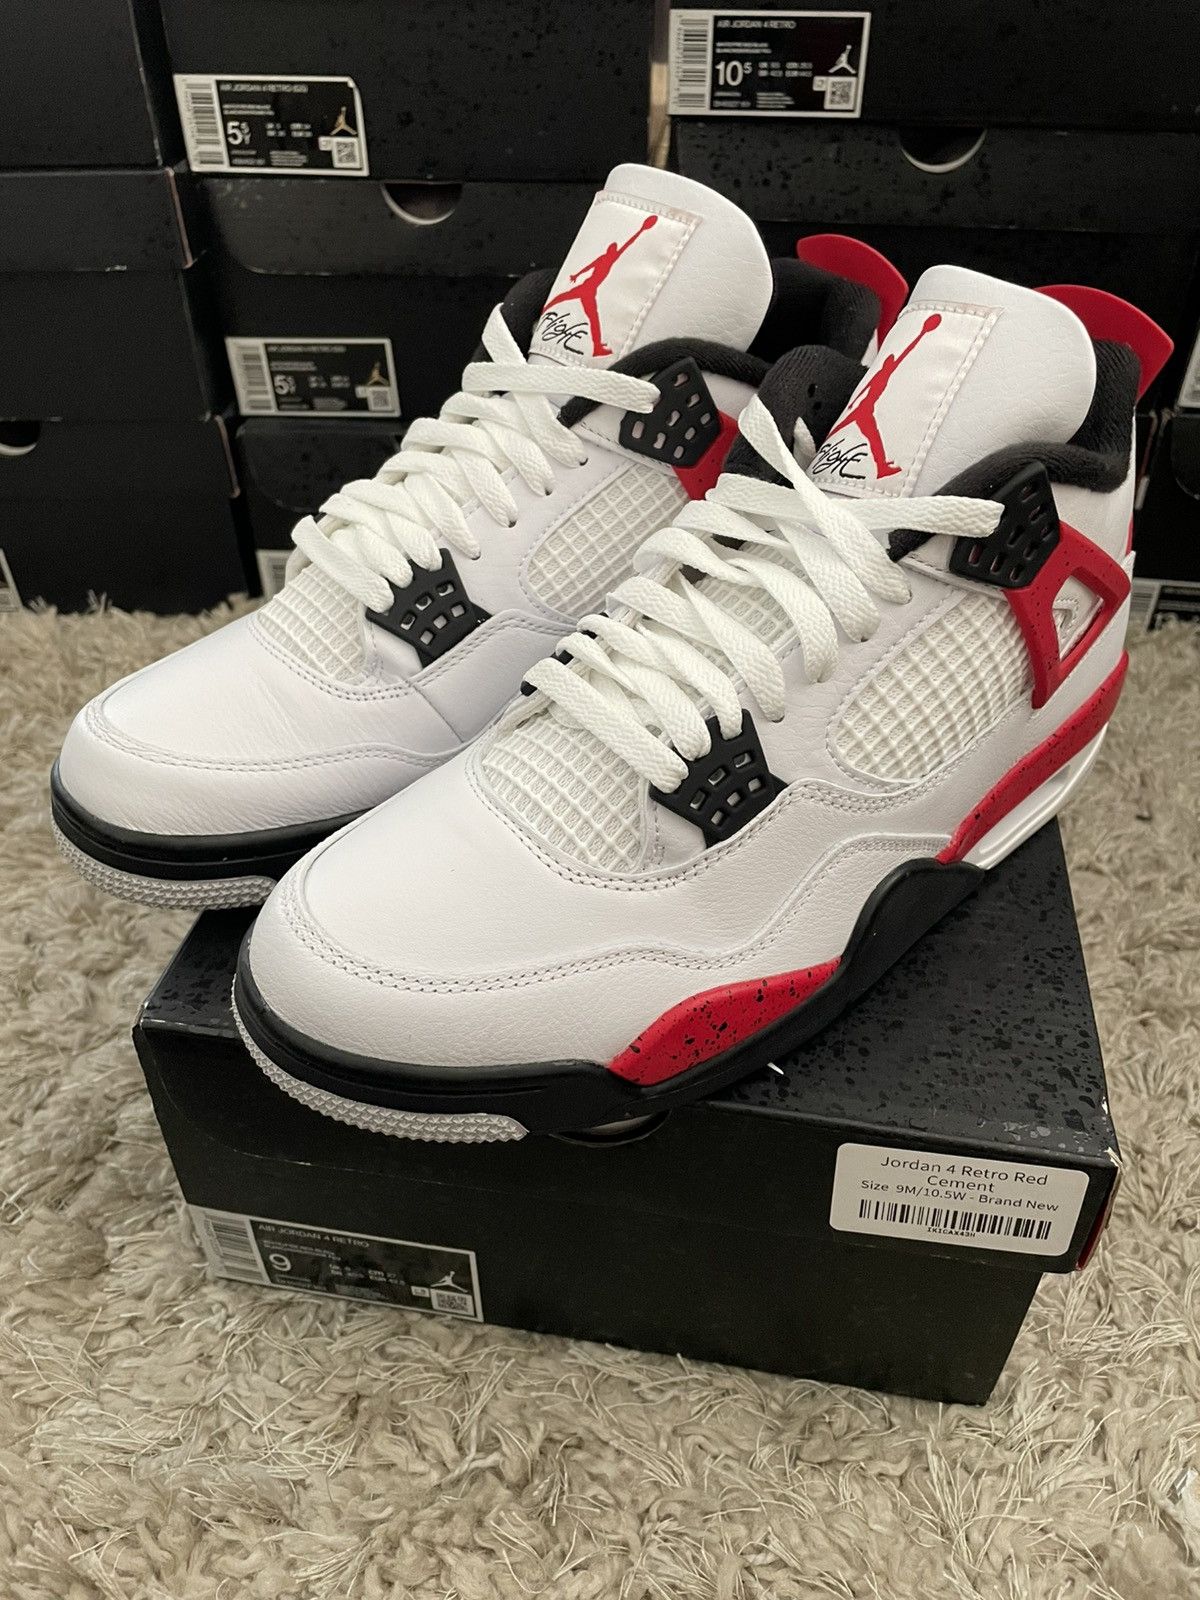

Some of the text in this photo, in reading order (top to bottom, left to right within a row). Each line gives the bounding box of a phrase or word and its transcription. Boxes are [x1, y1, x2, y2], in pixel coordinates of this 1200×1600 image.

[880, 1156, 1048, 1186] Jordan 4 Retro Red
[861, 1179, 890, 1192] Size
[895, 1185, 967, 1202] 9M/10.5W
[978, 1194, 1022, 1208] Brand
[1026, 1199, 1060, 1212] New
[927, 1175, 995, 1193] Cement
[258, 1224, 276, 1233] AIR
[278, 1227, 321, 1241] JORDAN
[332, 1236, 370, 1249] RETRO
[268, 1252, 292, 1273] 9
